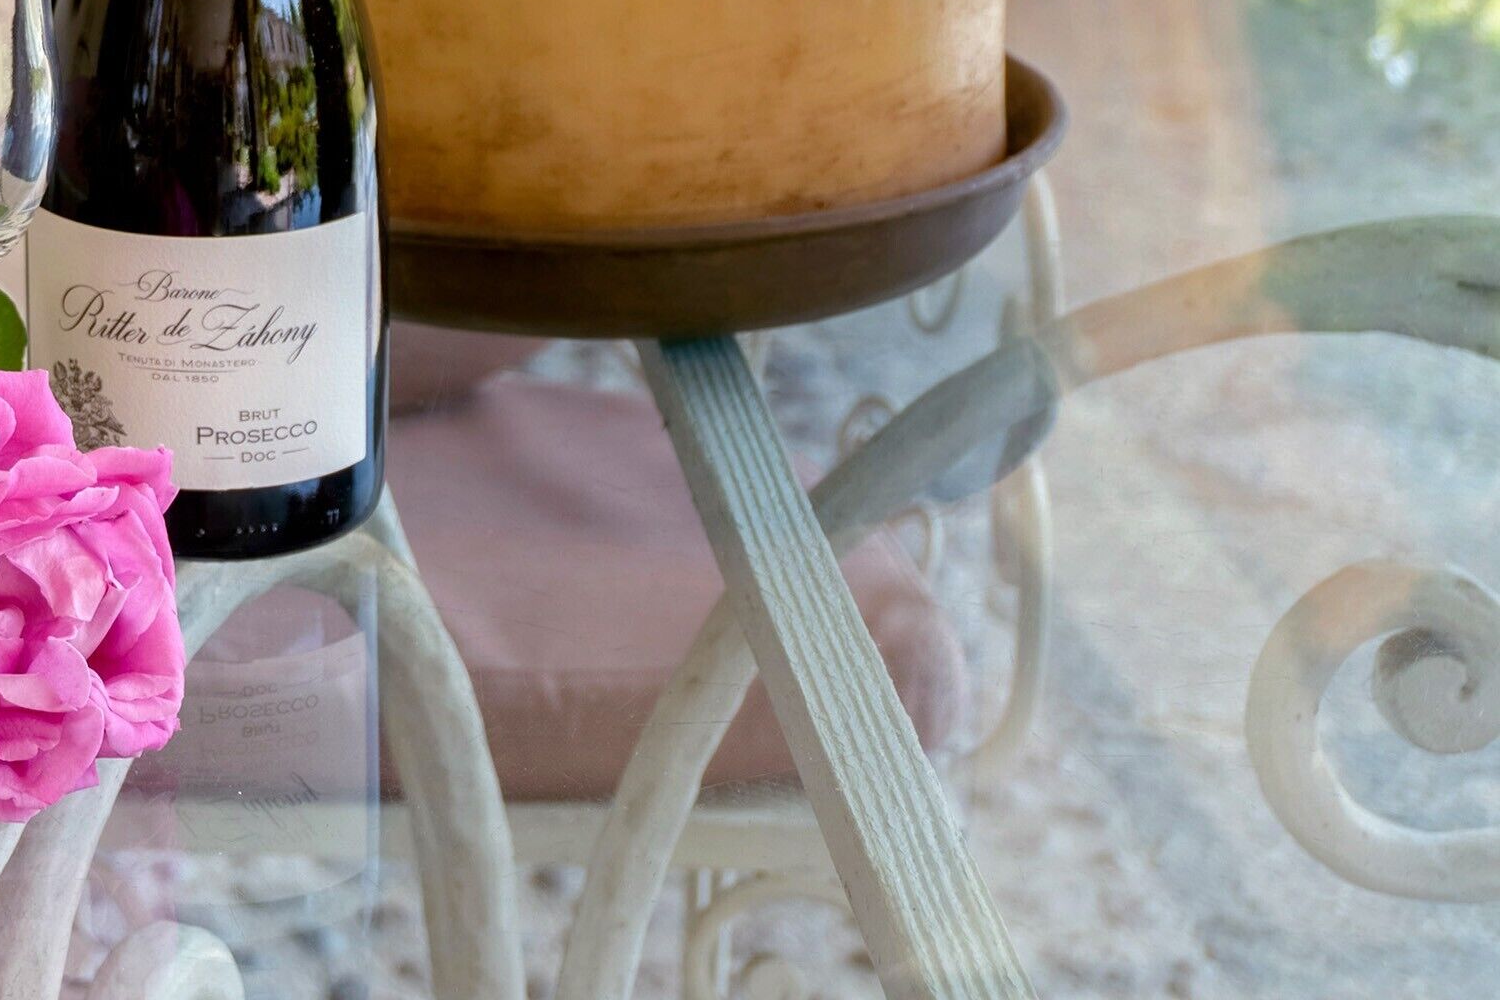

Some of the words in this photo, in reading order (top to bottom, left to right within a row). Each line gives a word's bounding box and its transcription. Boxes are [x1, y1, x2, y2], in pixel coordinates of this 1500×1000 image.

[117, 269, 252, 302] Barone
[58, 284, 150, 345] Ritter
[161, 308, 192, 341] de
[190, 303, 318, 364] Záhony
[118, 352, 164, 367] TENUTA
[181, 357, 257, 369] MONASTERO
[151, 373, 180, 384] DAL
[184, 374, 220, 384] 1850
[238, 407, 281, 423] BRUT
[196, 420, 318, 446] PROSECCO
[241, 450, 276, 463] DOC
